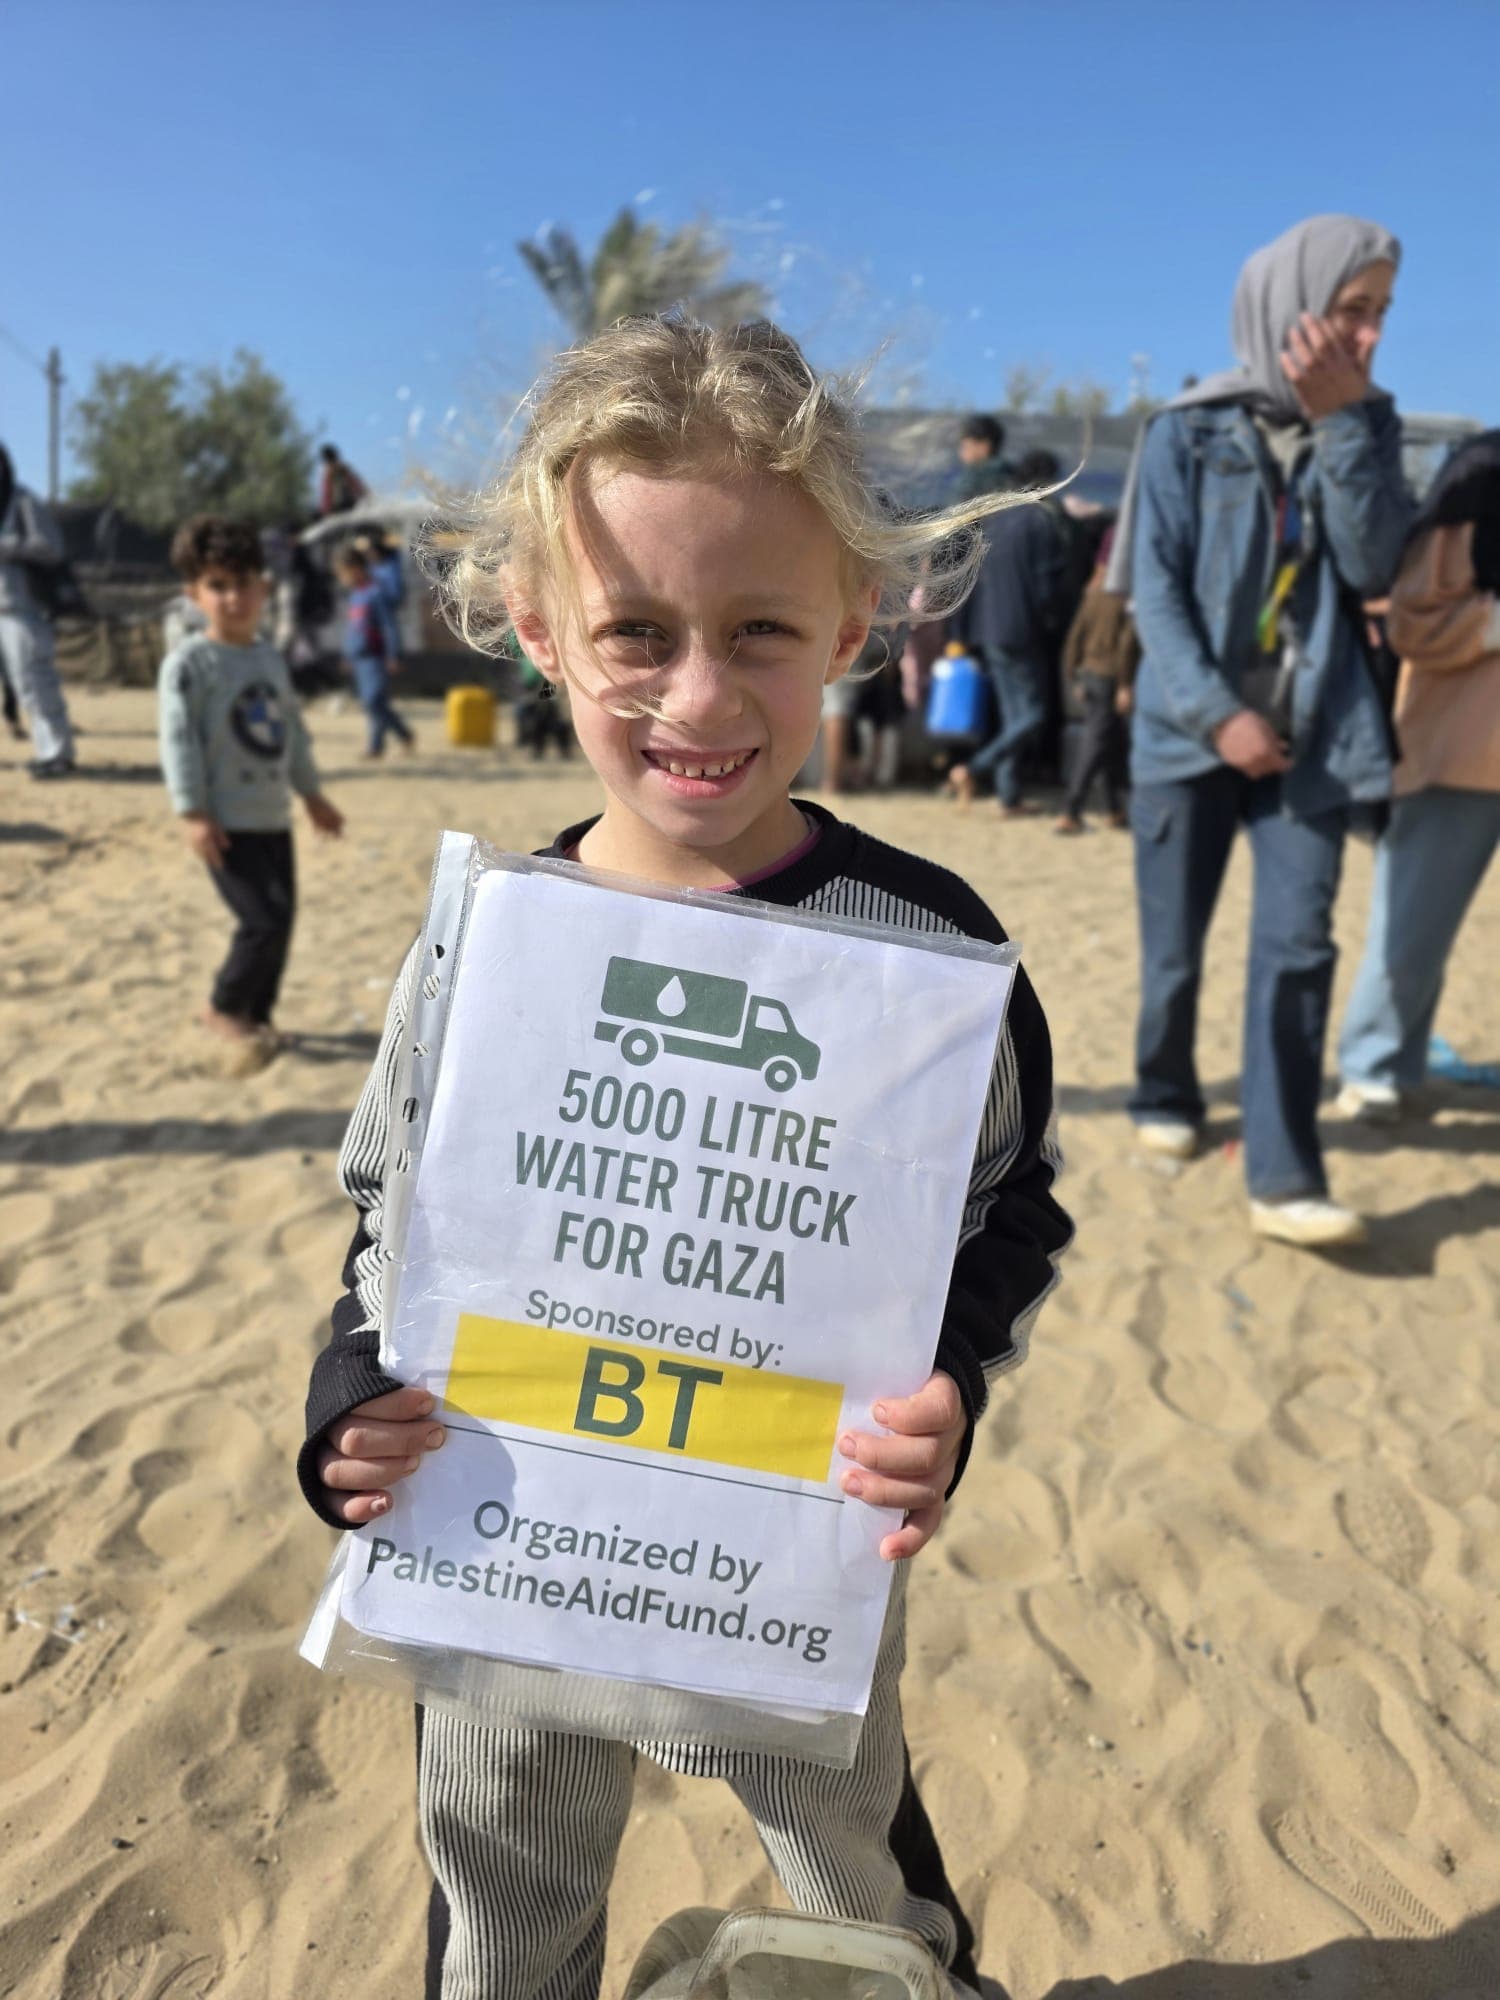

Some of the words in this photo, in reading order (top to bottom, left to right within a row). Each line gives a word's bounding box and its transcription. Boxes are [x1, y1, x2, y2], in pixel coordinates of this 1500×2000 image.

[559, 1068, 687, 1142] 5000
[699, 1096, 838, 1172] LITRE
[517, 1131, 679, 1213] WATER
[697, 1166, 857, 1246] TRUCK
[554, 1211, 649, 1279] FOR
[663, 1233, 785, 1305] GAZA
[526, 1290, 721, 1354] Sponsored
[730, 1328, 784, 1369] by:
[574, 1346, 724, 1451] BT
[474, 1501, 699, 1577] Organized
[709, 1544, 763, 1594] by
[366, 1537, 832, 1664] PalestineAidFund.org
